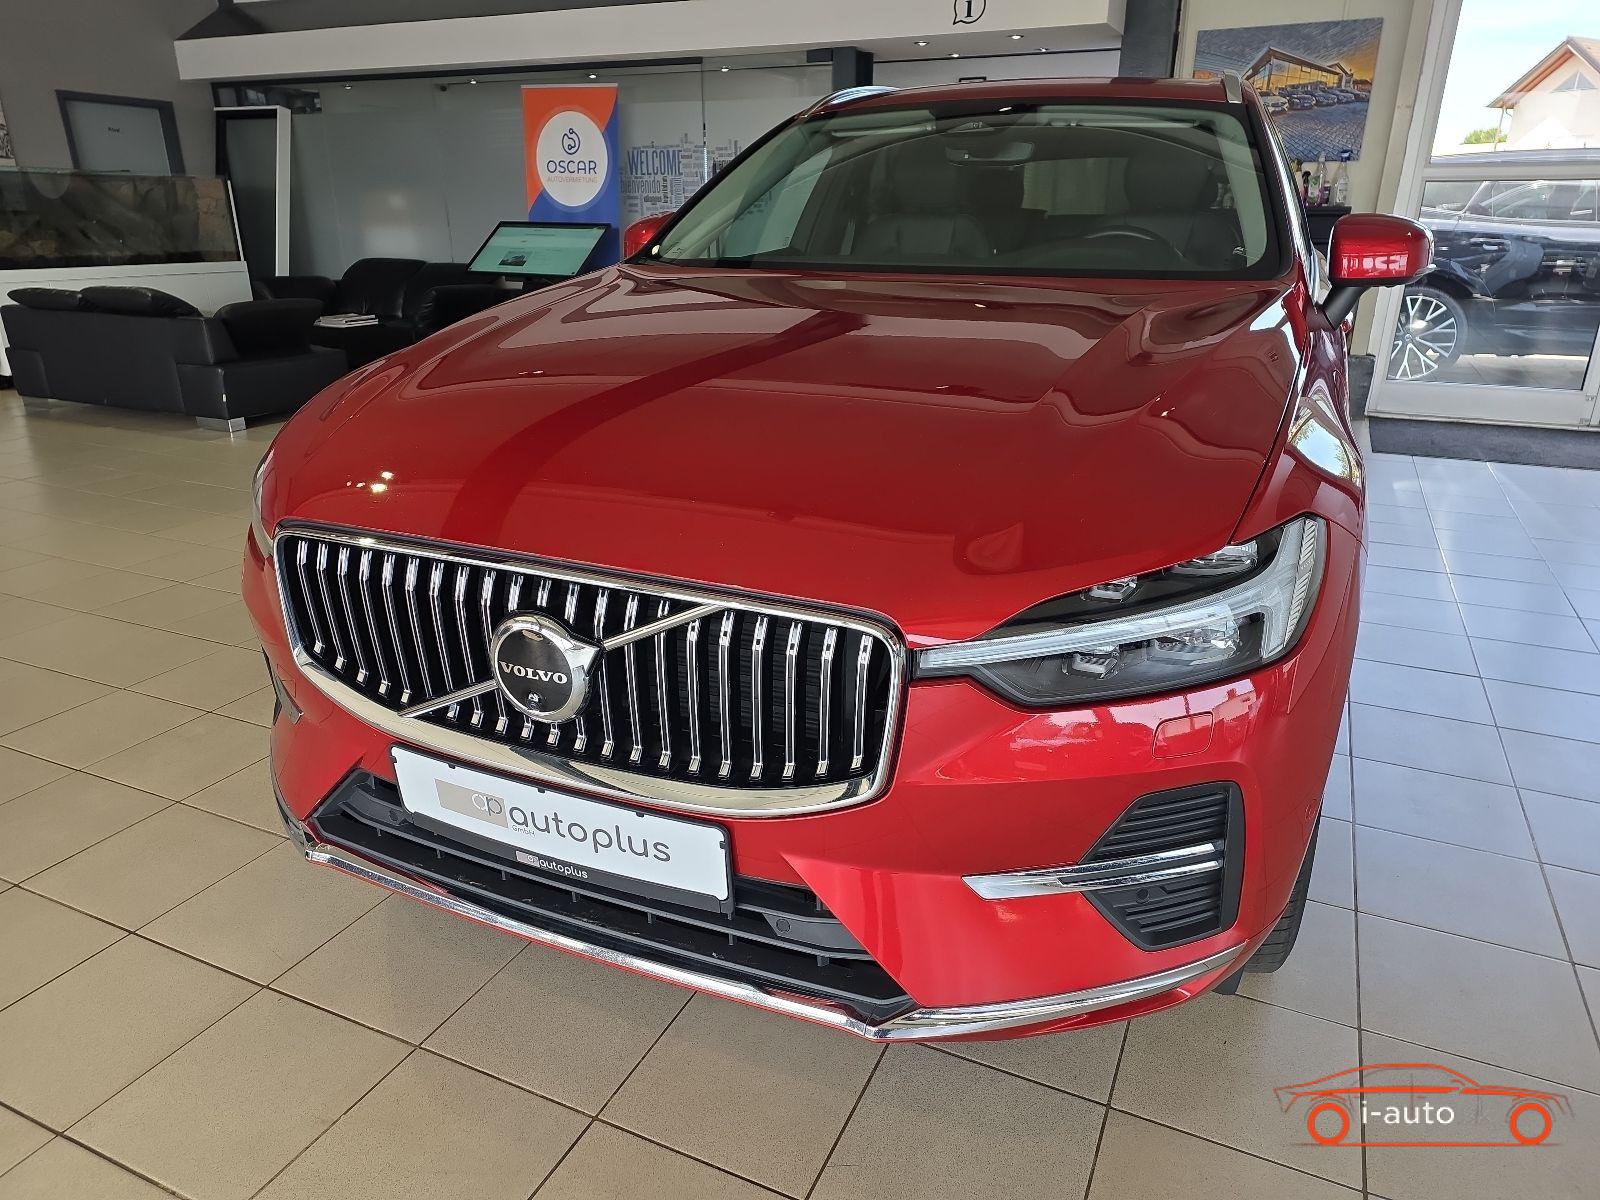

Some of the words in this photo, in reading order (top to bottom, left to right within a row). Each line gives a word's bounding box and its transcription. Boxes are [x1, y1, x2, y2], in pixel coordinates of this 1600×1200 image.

[547, 160, 597, 174] OSCAR
[628, 150, 683, 176] WELCOME
[498, 660, 568, 684] VOLVO
[509, 806, 671, 862] autoplus
[512, 825, 536, 838] GmbH
[539, 859, 588, 879] autoplus
